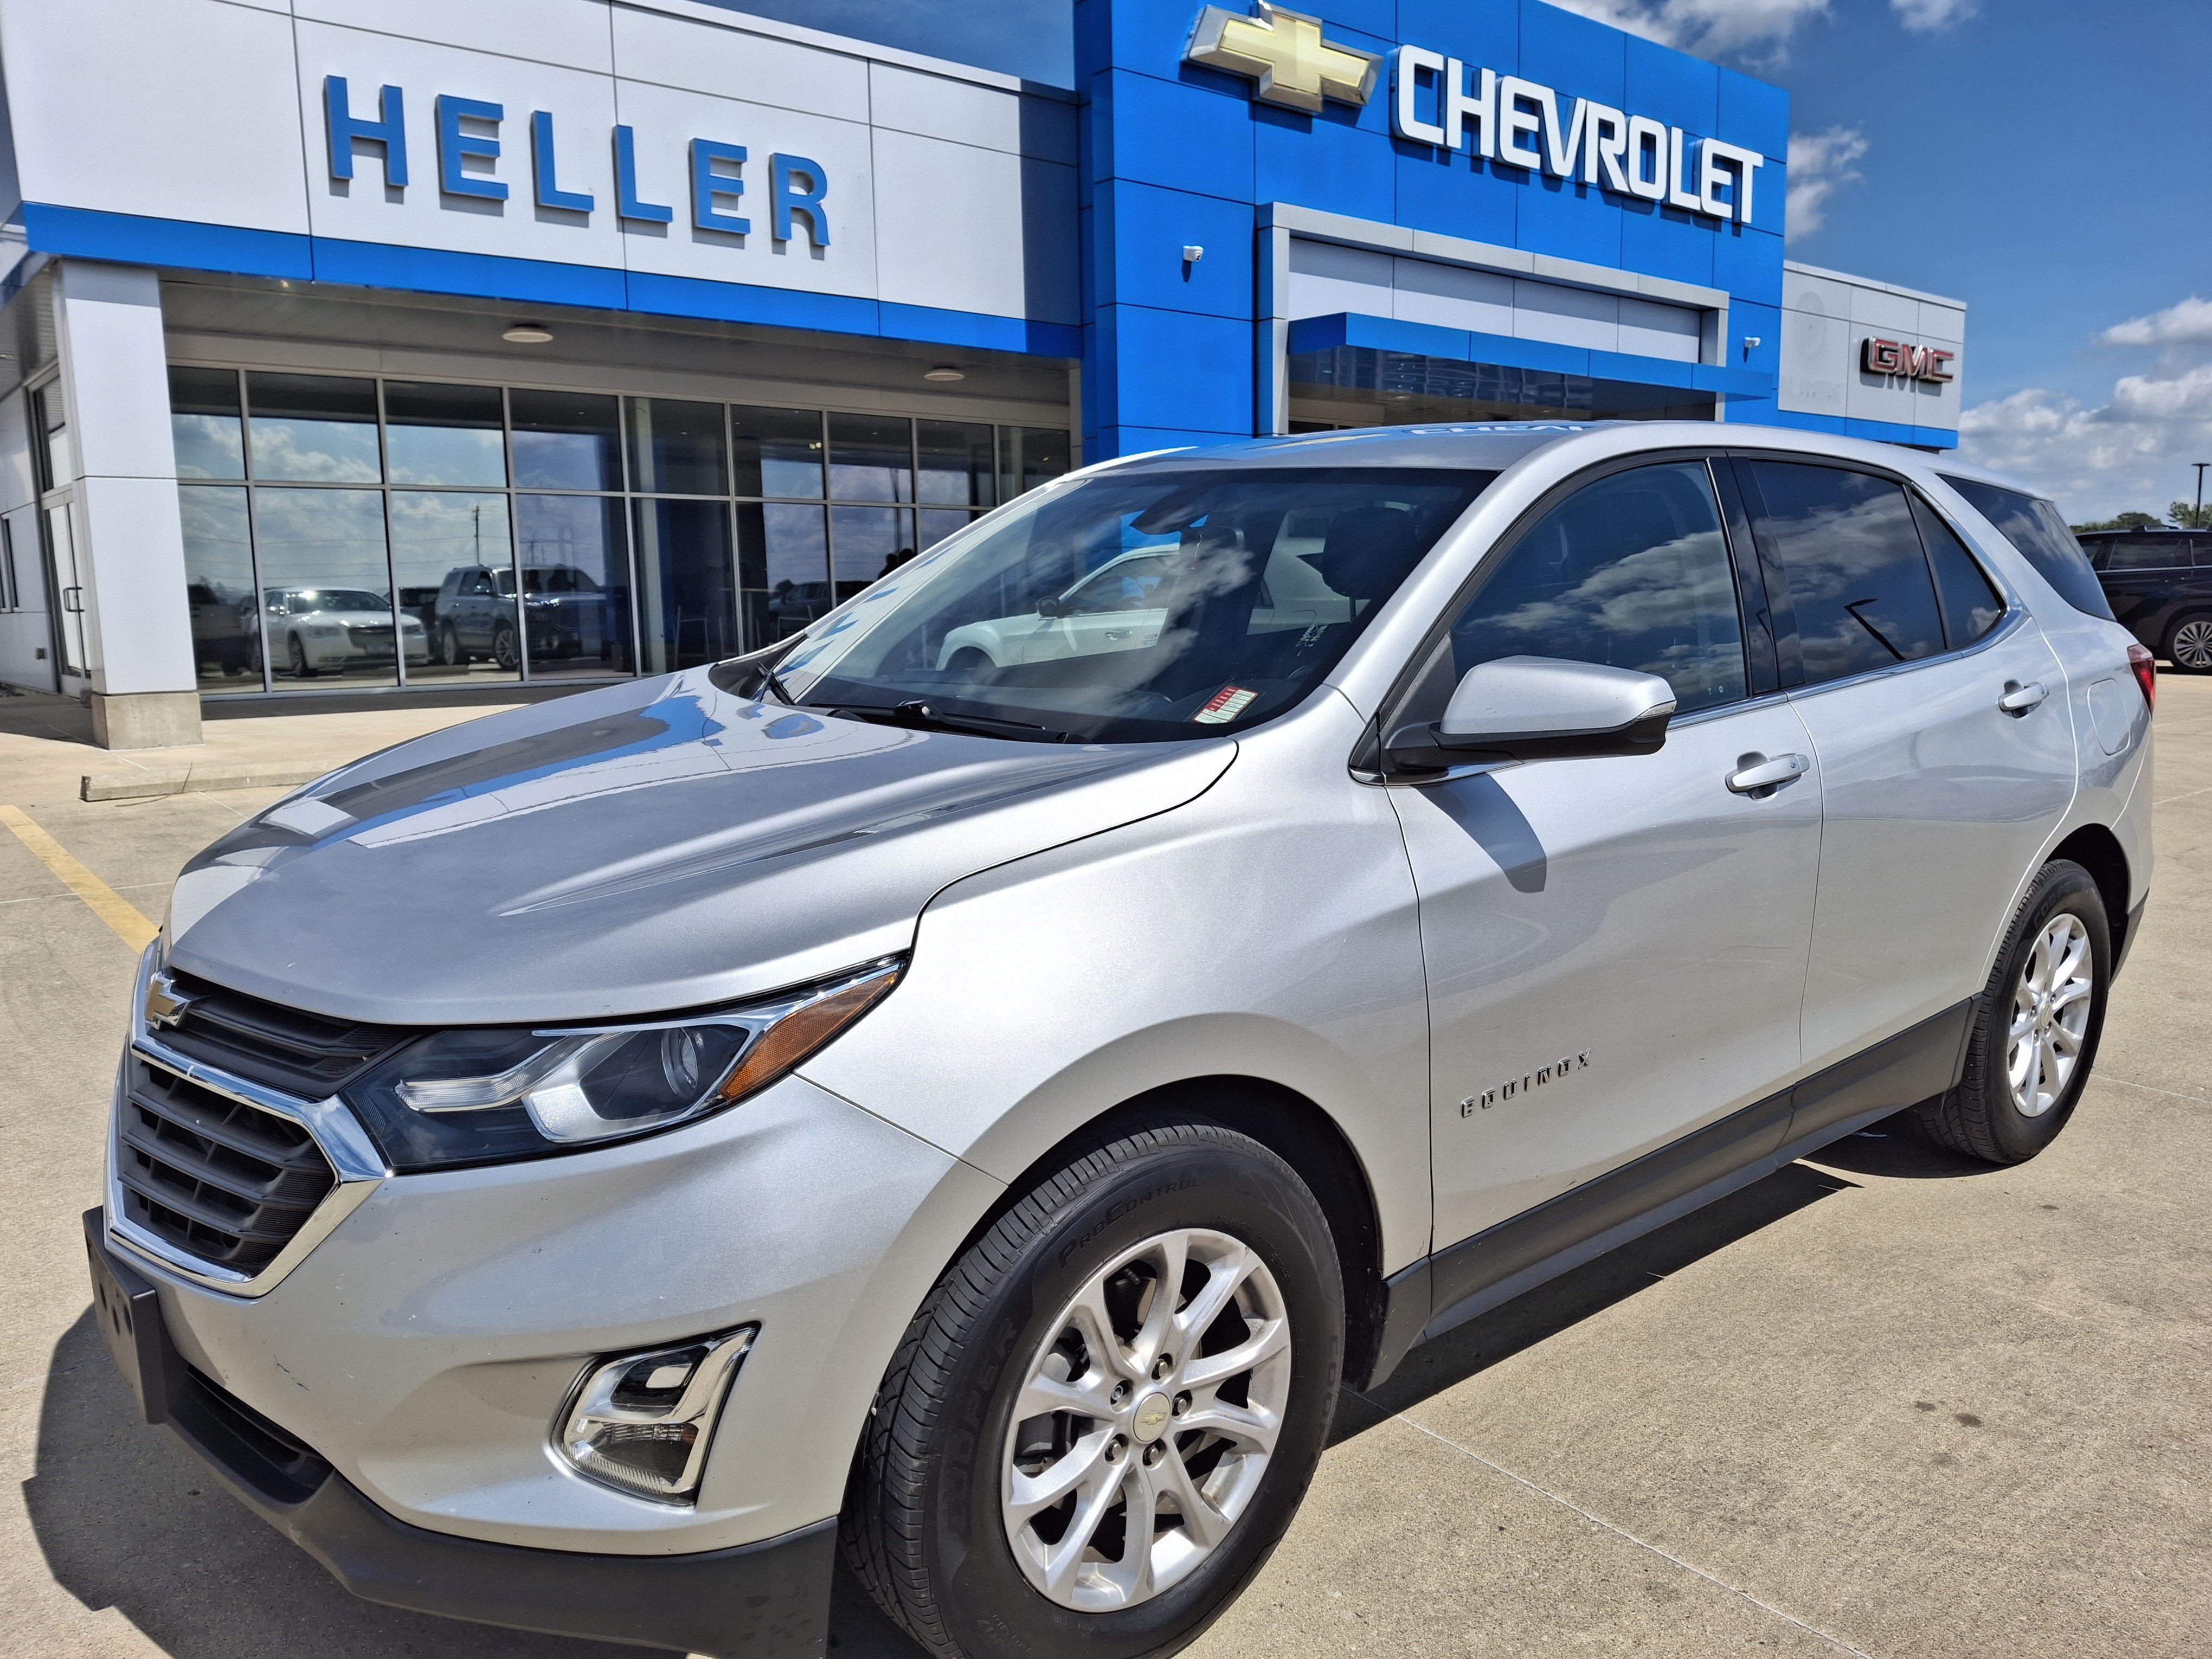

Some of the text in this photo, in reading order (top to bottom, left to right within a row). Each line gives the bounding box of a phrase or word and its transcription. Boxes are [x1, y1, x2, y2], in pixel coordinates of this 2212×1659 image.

[324, 74, 830, 246] HELLER
[1392, 43, 1764, 223] CHEVROLET
[1868, 336, 1954, 383] GMC
[1461, 1048, 1591, 1119] EQUINOX
